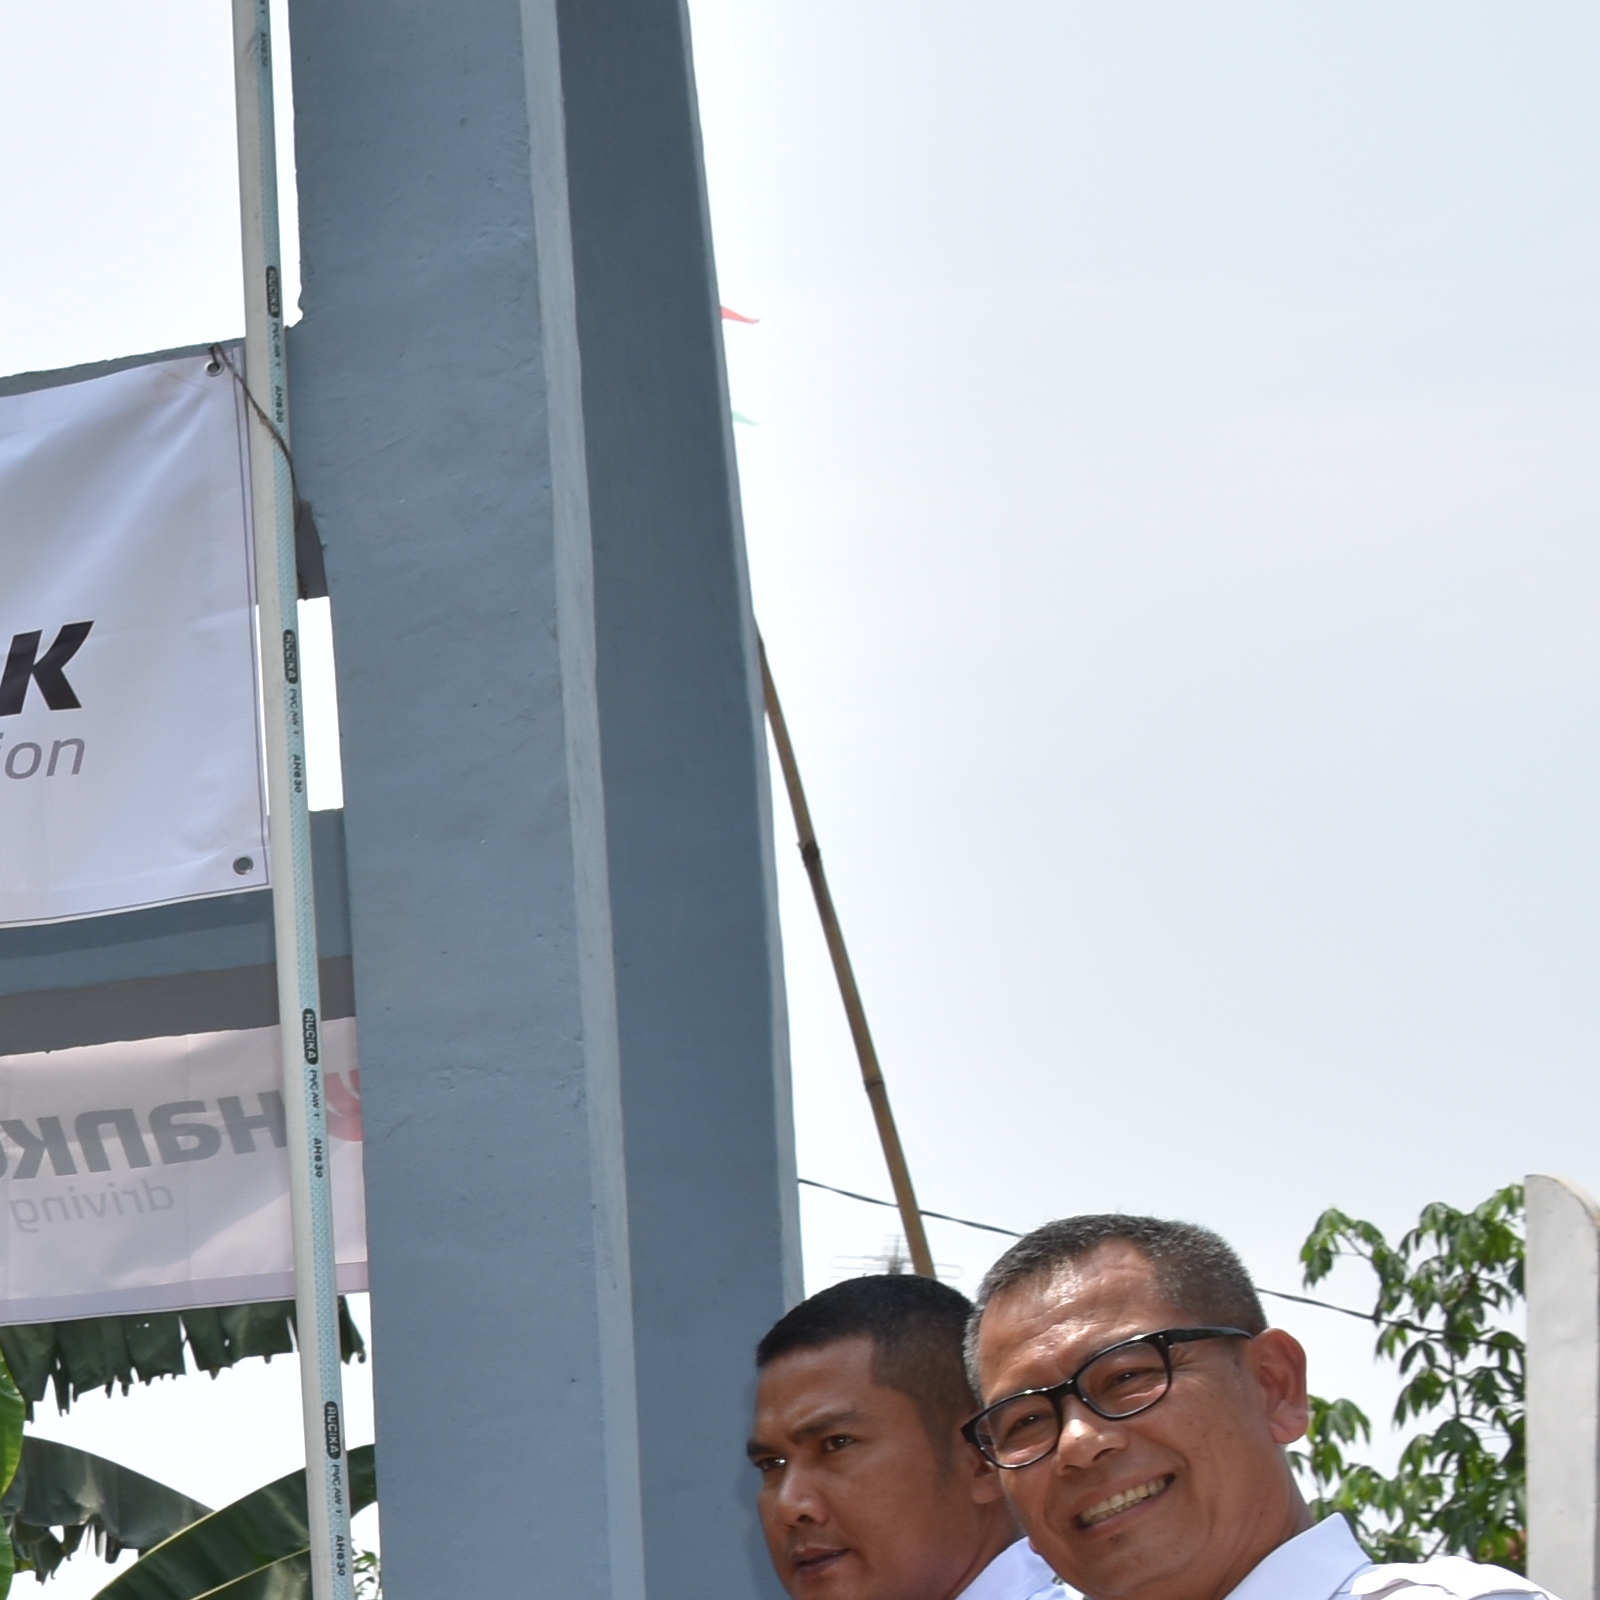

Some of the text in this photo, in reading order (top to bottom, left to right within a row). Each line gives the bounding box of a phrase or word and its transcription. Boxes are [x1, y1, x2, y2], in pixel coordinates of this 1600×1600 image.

[304, 1012, 317, 1061] RUCIKA
[326, 1405, 339, 1455] RUCIKA
[335, 1534, 345, 1577] AH830
